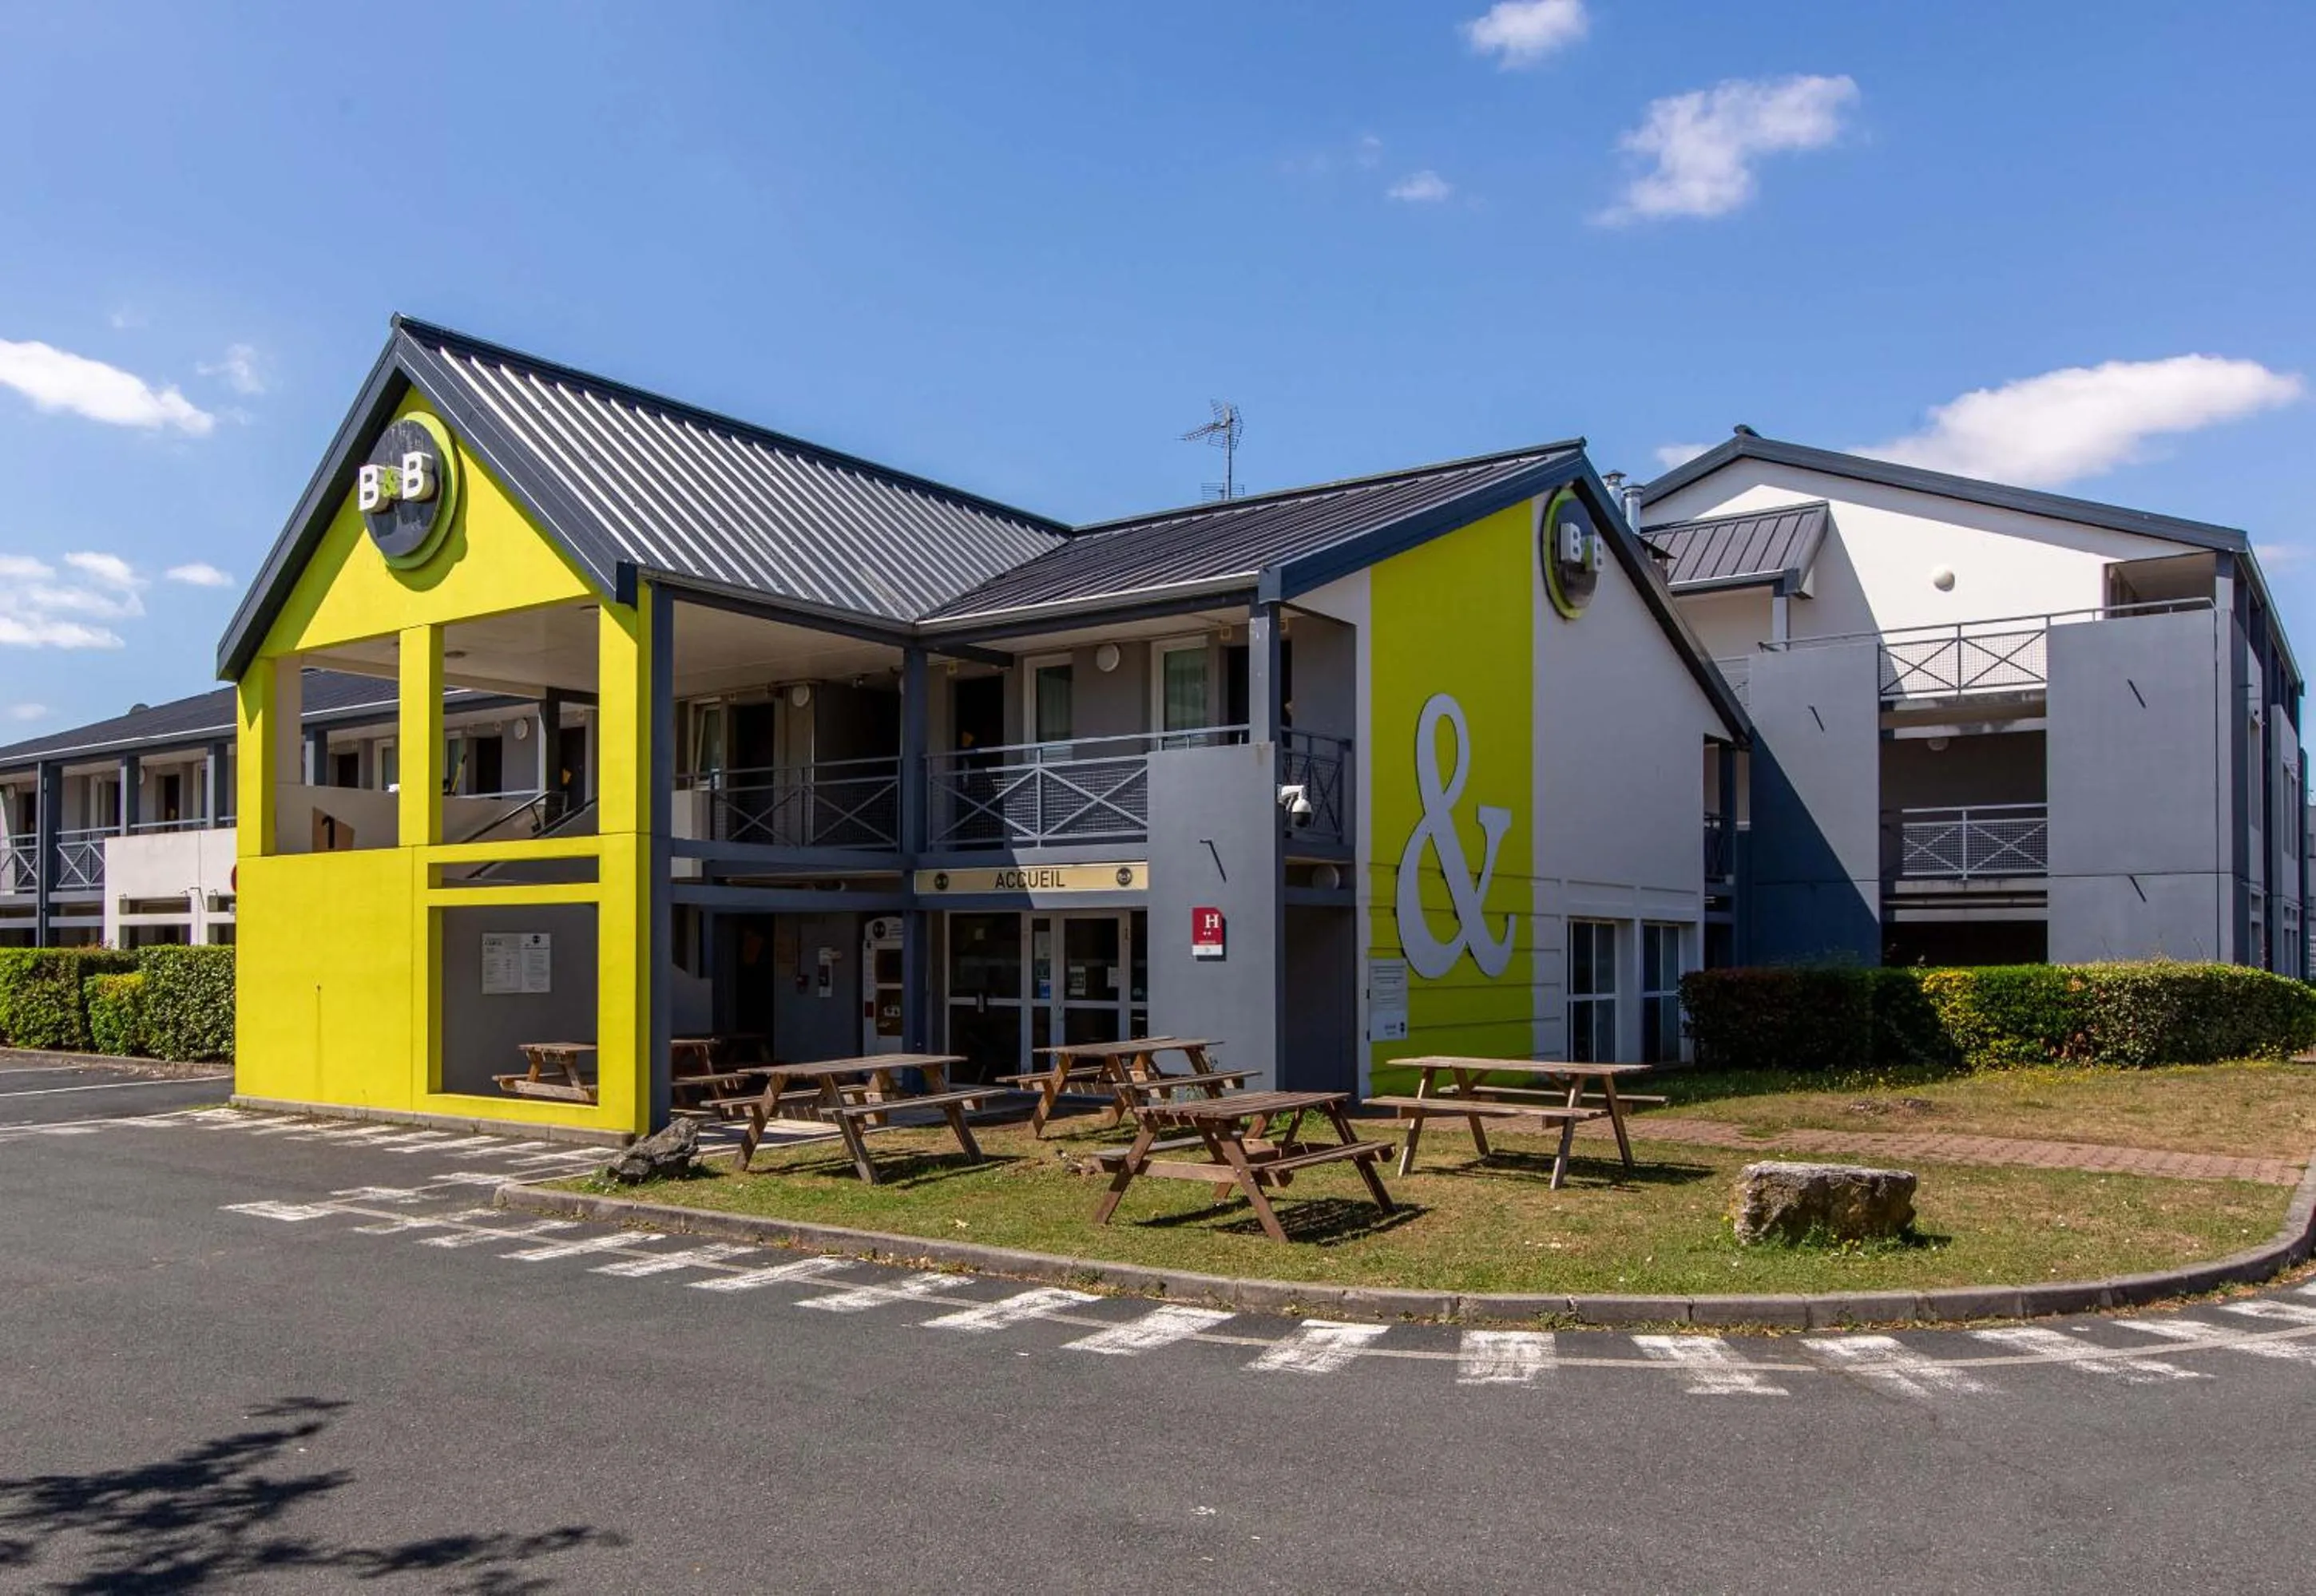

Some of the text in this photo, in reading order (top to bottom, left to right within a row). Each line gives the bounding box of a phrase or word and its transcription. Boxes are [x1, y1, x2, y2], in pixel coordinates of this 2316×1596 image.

[359, 450, 426, 511] B&B
[1395, 692, 1517, 980] &
[995, 870, 1066, 889] ACCUEIL
[1204, 913, 1219, 929] H
